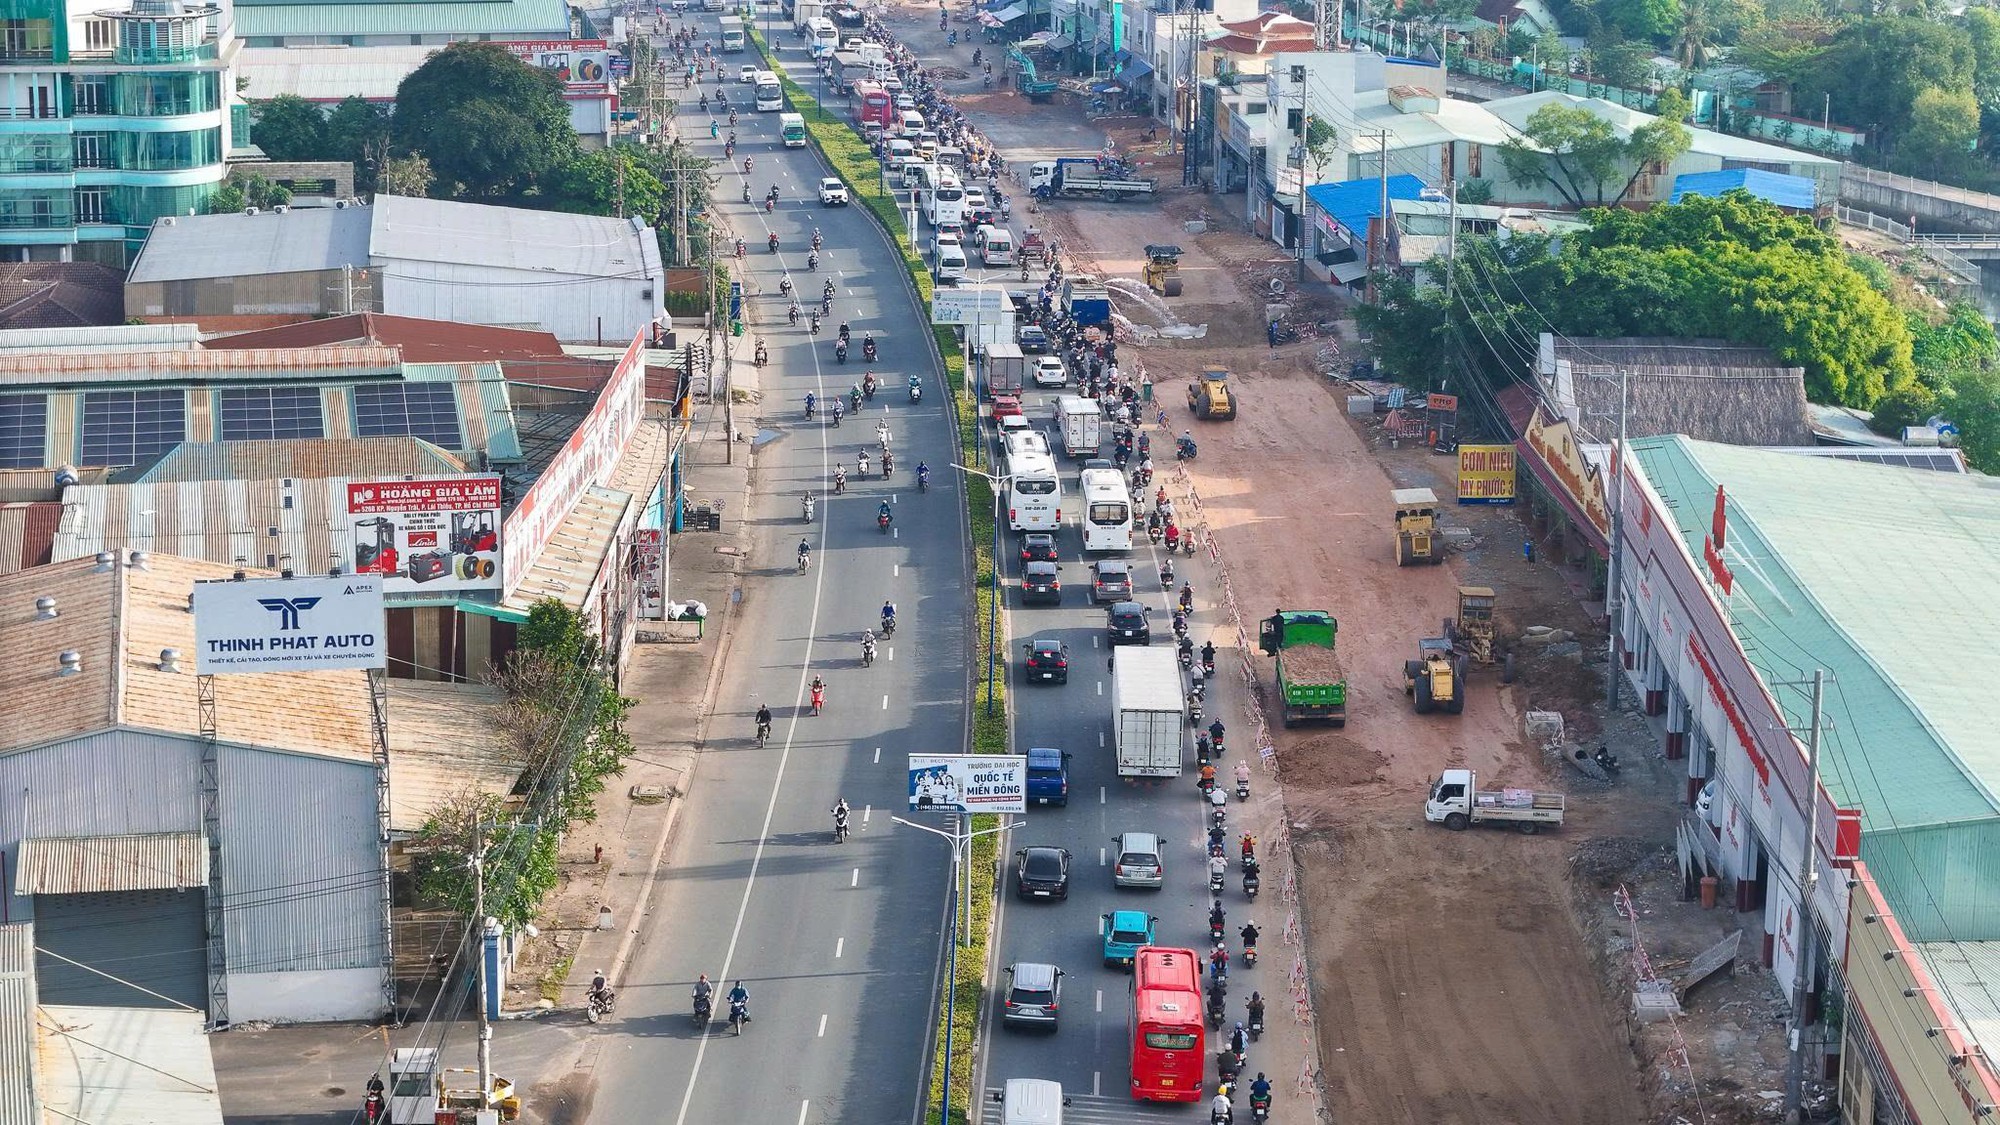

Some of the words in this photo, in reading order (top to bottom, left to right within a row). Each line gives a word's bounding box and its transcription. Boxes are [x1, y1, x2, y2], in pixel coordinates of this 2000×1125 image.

[1462, 450, 1486, 472] CƠM
[1488, 448, 1514, 472] NIÊU
[380, 487, 431, 498] HOÀNG
[436, 487, 460, 497] GIA
[464, 484, 496, 496] LÂM
[1476, 477, 1506, 496] PHƯỚC
[1508, 480, 1514, 496] 3
[413, 538, 437, 546] Linde
[207, 638, 264, 652] THINH
[270, 636, 318, 650] PHAT
[324, 634, 374, 648] AUTO
[967, 762, 992, 770] TRƯỜNG
[974, 770, 1000, 783] QUỐC
[1003, 769, 1014, 782] TẾ
[994, 783, 1020, 794] ĐÔNG
